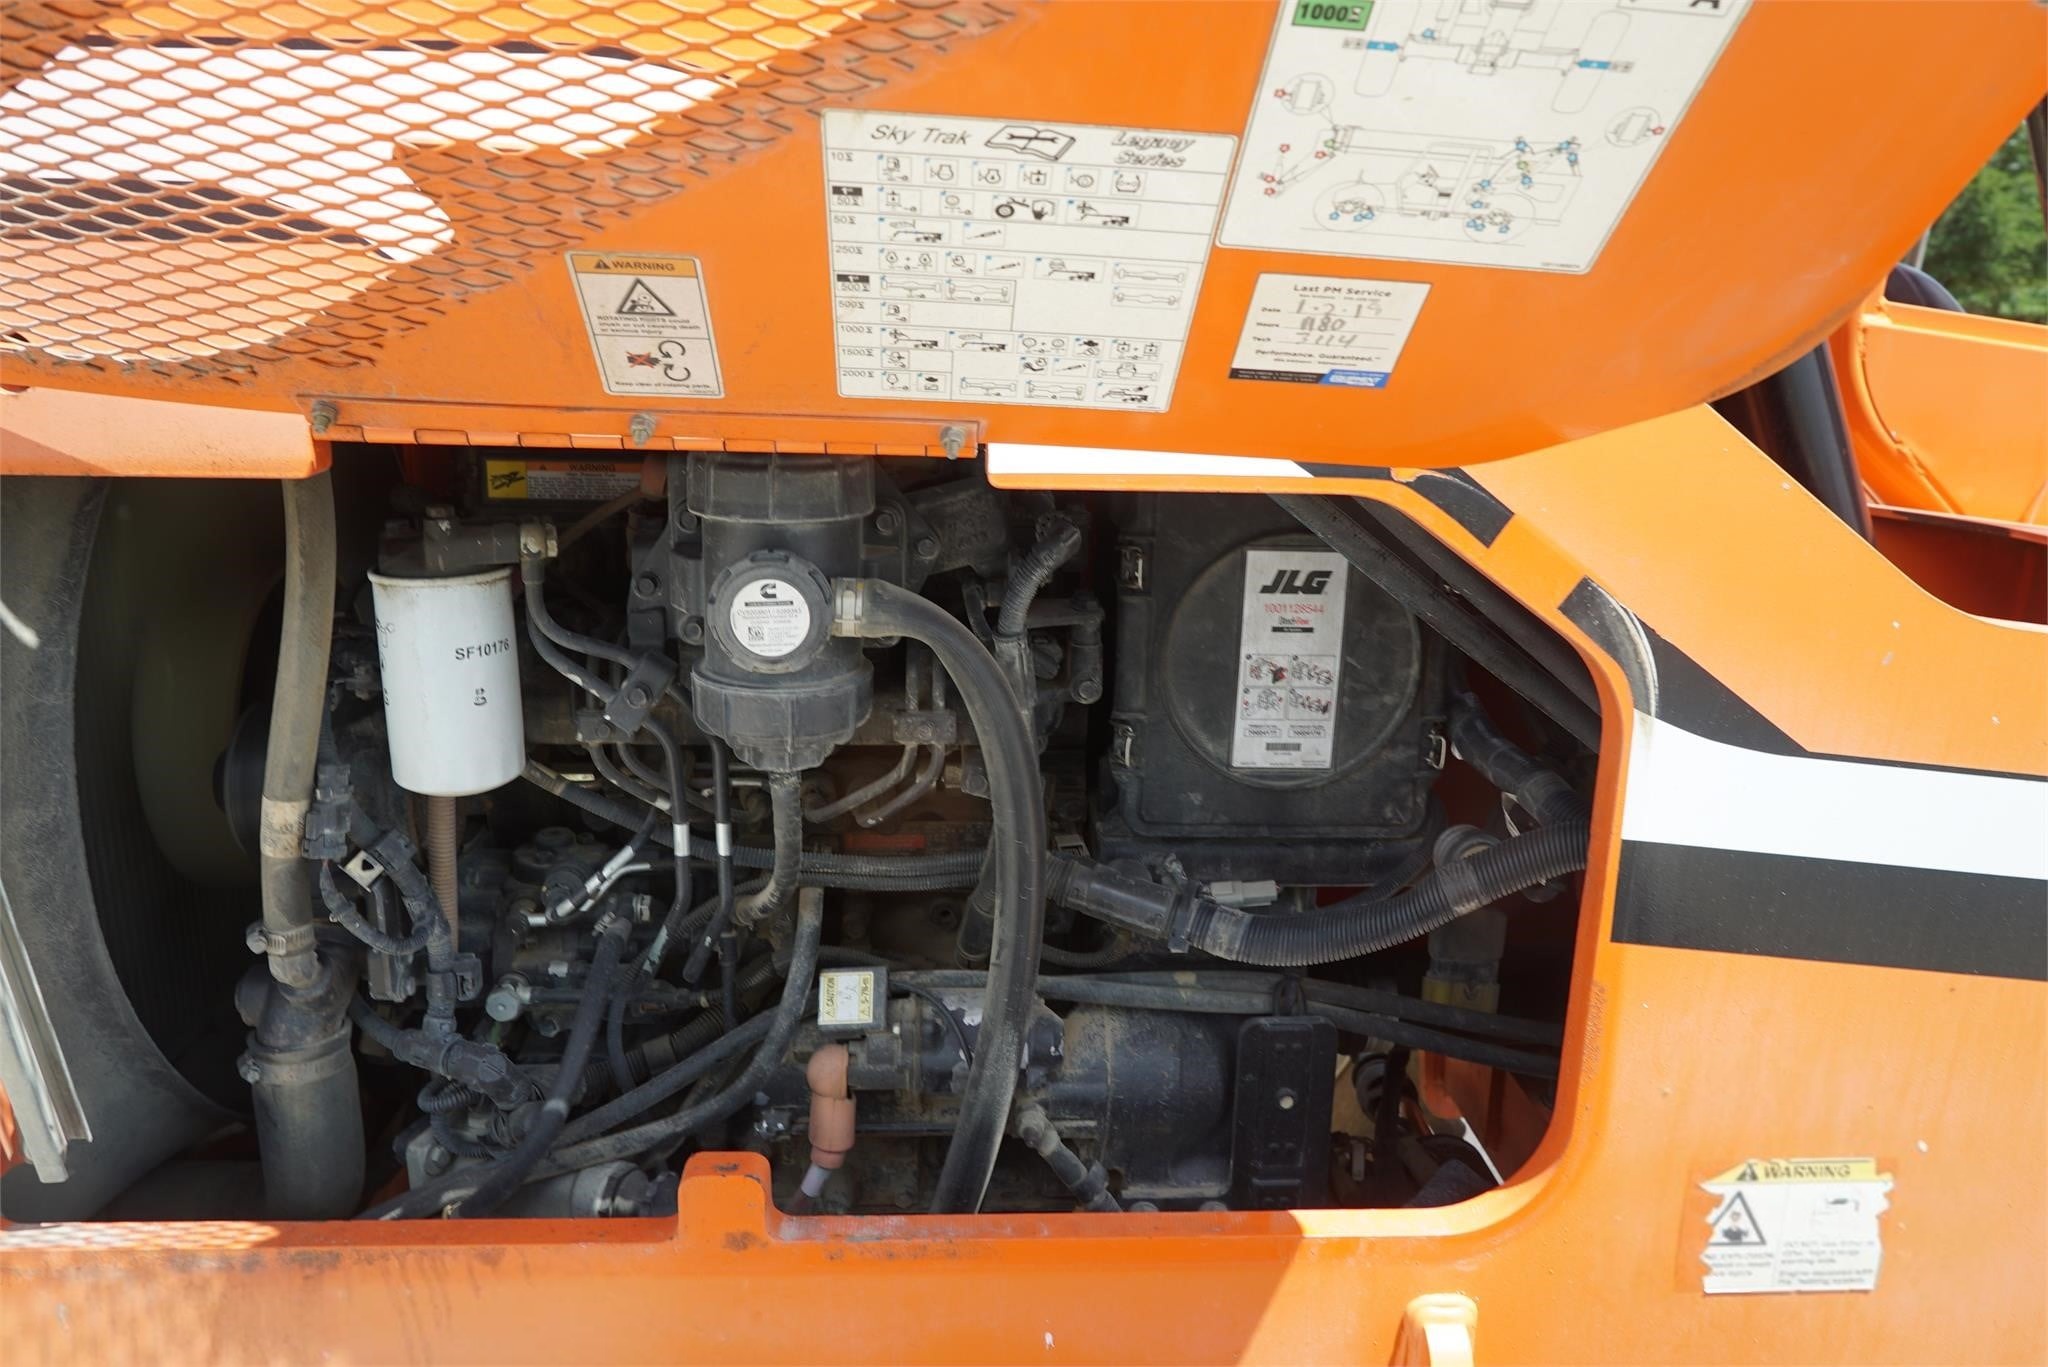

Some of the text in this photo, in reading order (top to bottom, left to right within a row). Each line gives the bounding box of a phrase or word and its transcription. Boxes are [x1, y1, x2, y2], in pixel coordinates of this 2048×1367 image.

[1301, 2, 1348, 22] 1000
[871, 124, 972, 146] Sky Trak
[1113, 150, 1187, 168] Series
[835, 245, 856, 255] 250
[611, 259, 675, 271] WARNING
[1294, 284, 1392, 297] Last PM Service
[840, 325, 865, 334] 1000
[841, 348, 865, 356] 1500
[842, 370, 866, 378] 2000
[569, 463, 616, 472] WARNING
[1258, 569, 1334, 595] JLG
[454, 637, 510, 661] SF10176
[1763, 1163, 1851, 1180] WARNING
